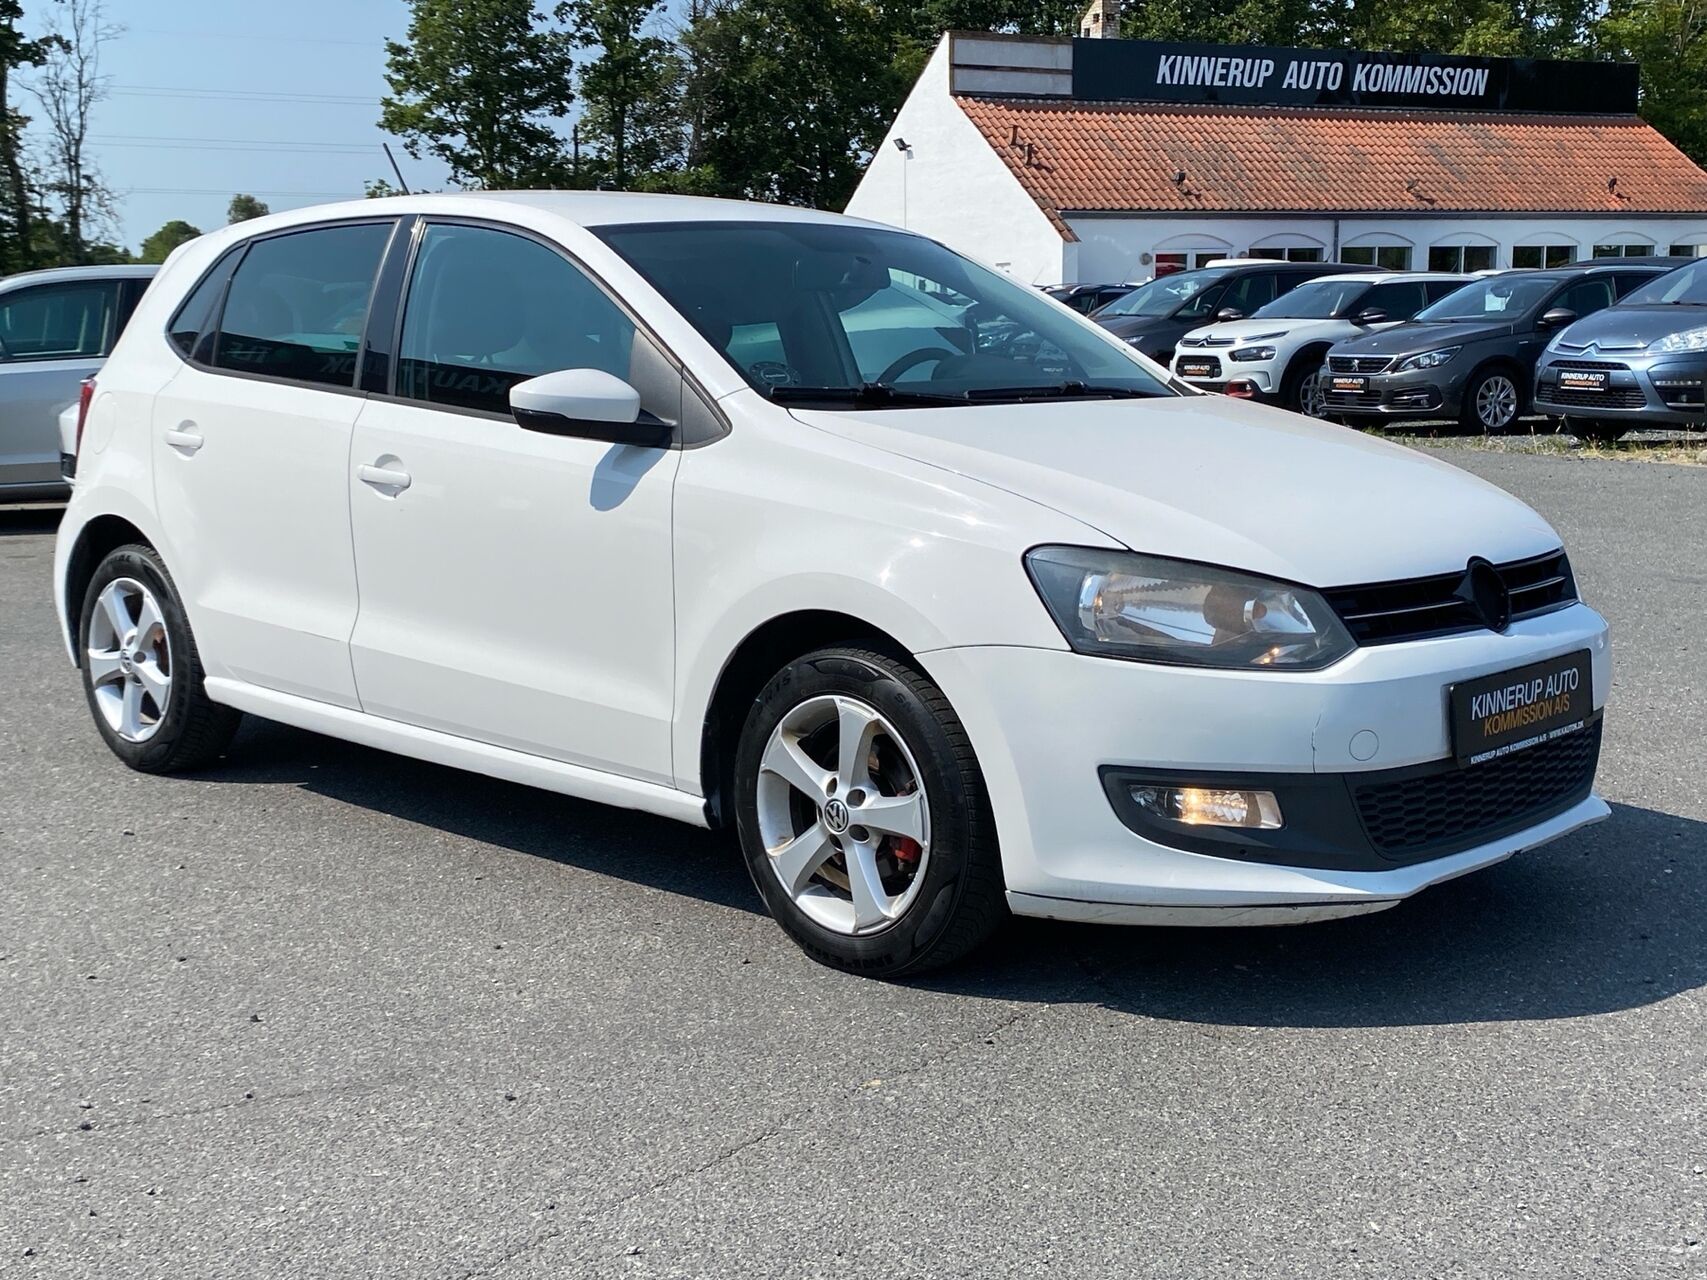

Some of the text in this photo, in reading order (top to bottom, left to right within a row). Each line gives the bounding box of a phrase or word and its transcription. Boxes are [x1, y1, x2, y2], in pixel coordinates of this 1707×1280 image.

[1156, 54, 1489, 96] KINNERUP AUTO KOMMISSION
[1561, 372, 1605, 382] KINNERUP AUTO
[1471, 667, 1579, 721] KINNERUP AUTO
[1484, 693, 1570, 737] KOMMISSION A/S
[1470, 750, 1497, 765] KINNERUP
